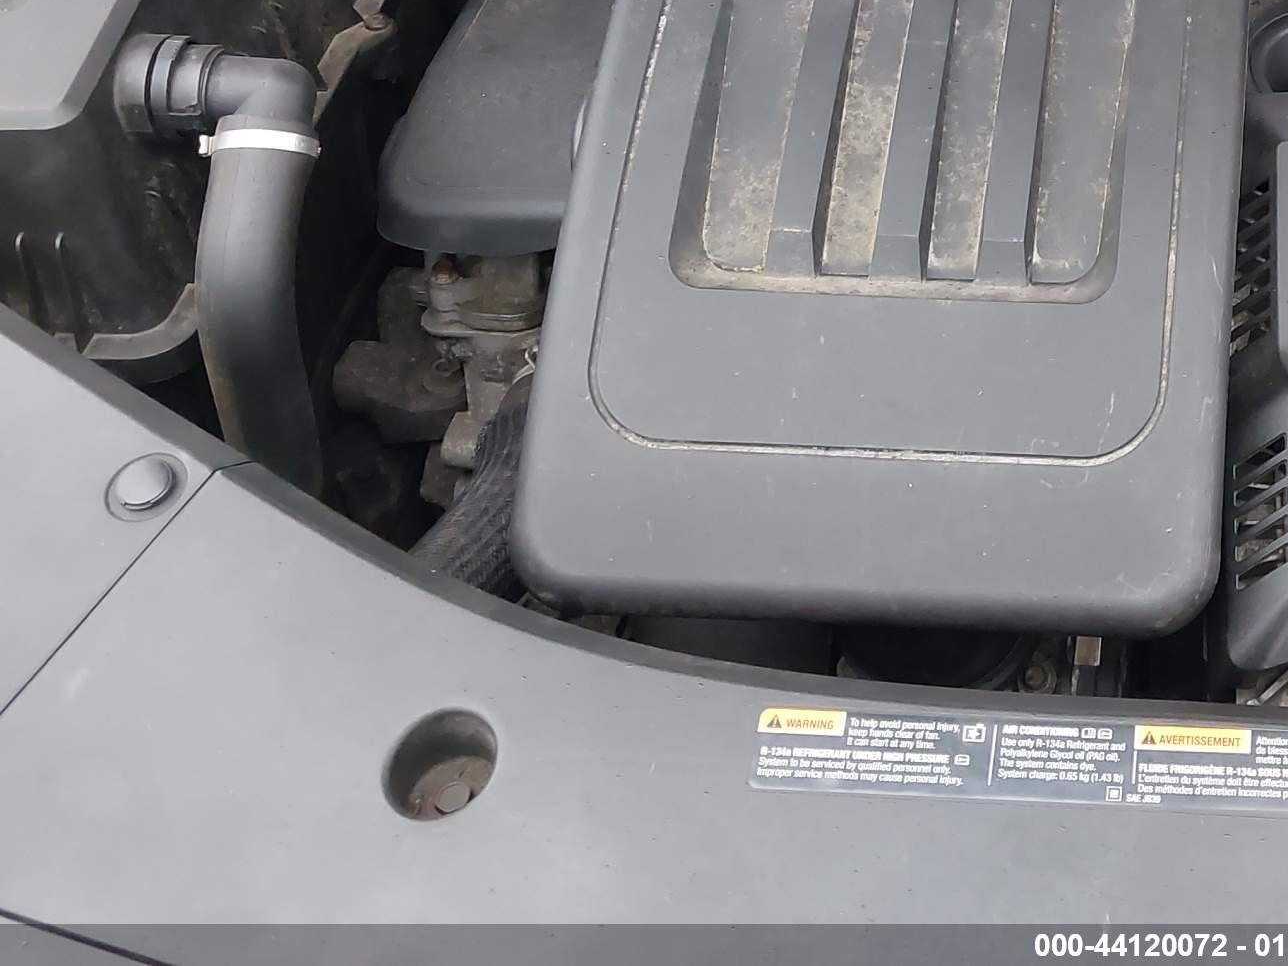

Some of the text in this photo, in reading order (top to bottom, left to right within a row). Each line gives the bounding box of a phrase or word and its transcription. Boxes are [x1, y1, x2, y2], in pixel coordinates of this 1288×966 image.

[786, 719, 834, 730] WARNING
[850, 717, 960, 733] To help avoid personal injury,
[848, 727, 940, 740] keep hands clear of fan.
[853, 738, 869, 746] can
[870, 739, 889, 747] start
[890, 739, 898, 748] at
[899, 740, 915, 750] any
[915, 741, 936, 750] time.
[1001, 737, 1126, 751] Use only R-134a Refrigerant and
[1159, 735, 1241, 747] AVERTISSEMENT
[1000, 748, 1120, 762] Polyalkylene Glycol oil (PAG oil).
[1256, 756, 1281, 765] mettre
[1282, 756, 1288, 765] à
[758, 757, 951, 775] System to be serviced by qualified personnel only.
[1000, 758, 1096, 772] The system contains dye.
[757, 767, 964, 786] Improper service methods may cause personal injury.
[998, 769, 1027, 779] System
[1059, 772, 1078, 781] 0.65
[1079, 773, 1090, 783] kg
[1091, 773, 1112, 783] (1.43
[1113, 774, 1124, 784] lb)
[1180, 775, 1192, 785] du
[1192, 776, 1225, 787] système
[1226, 777, 1242, 786] doit
[1243, 778, 1259, 787] être
[1137, 784, 1154, 793] Des
[1155, 785, 1194, 795] méthodes
[1238, 788, 1281, 798] incorrectes
